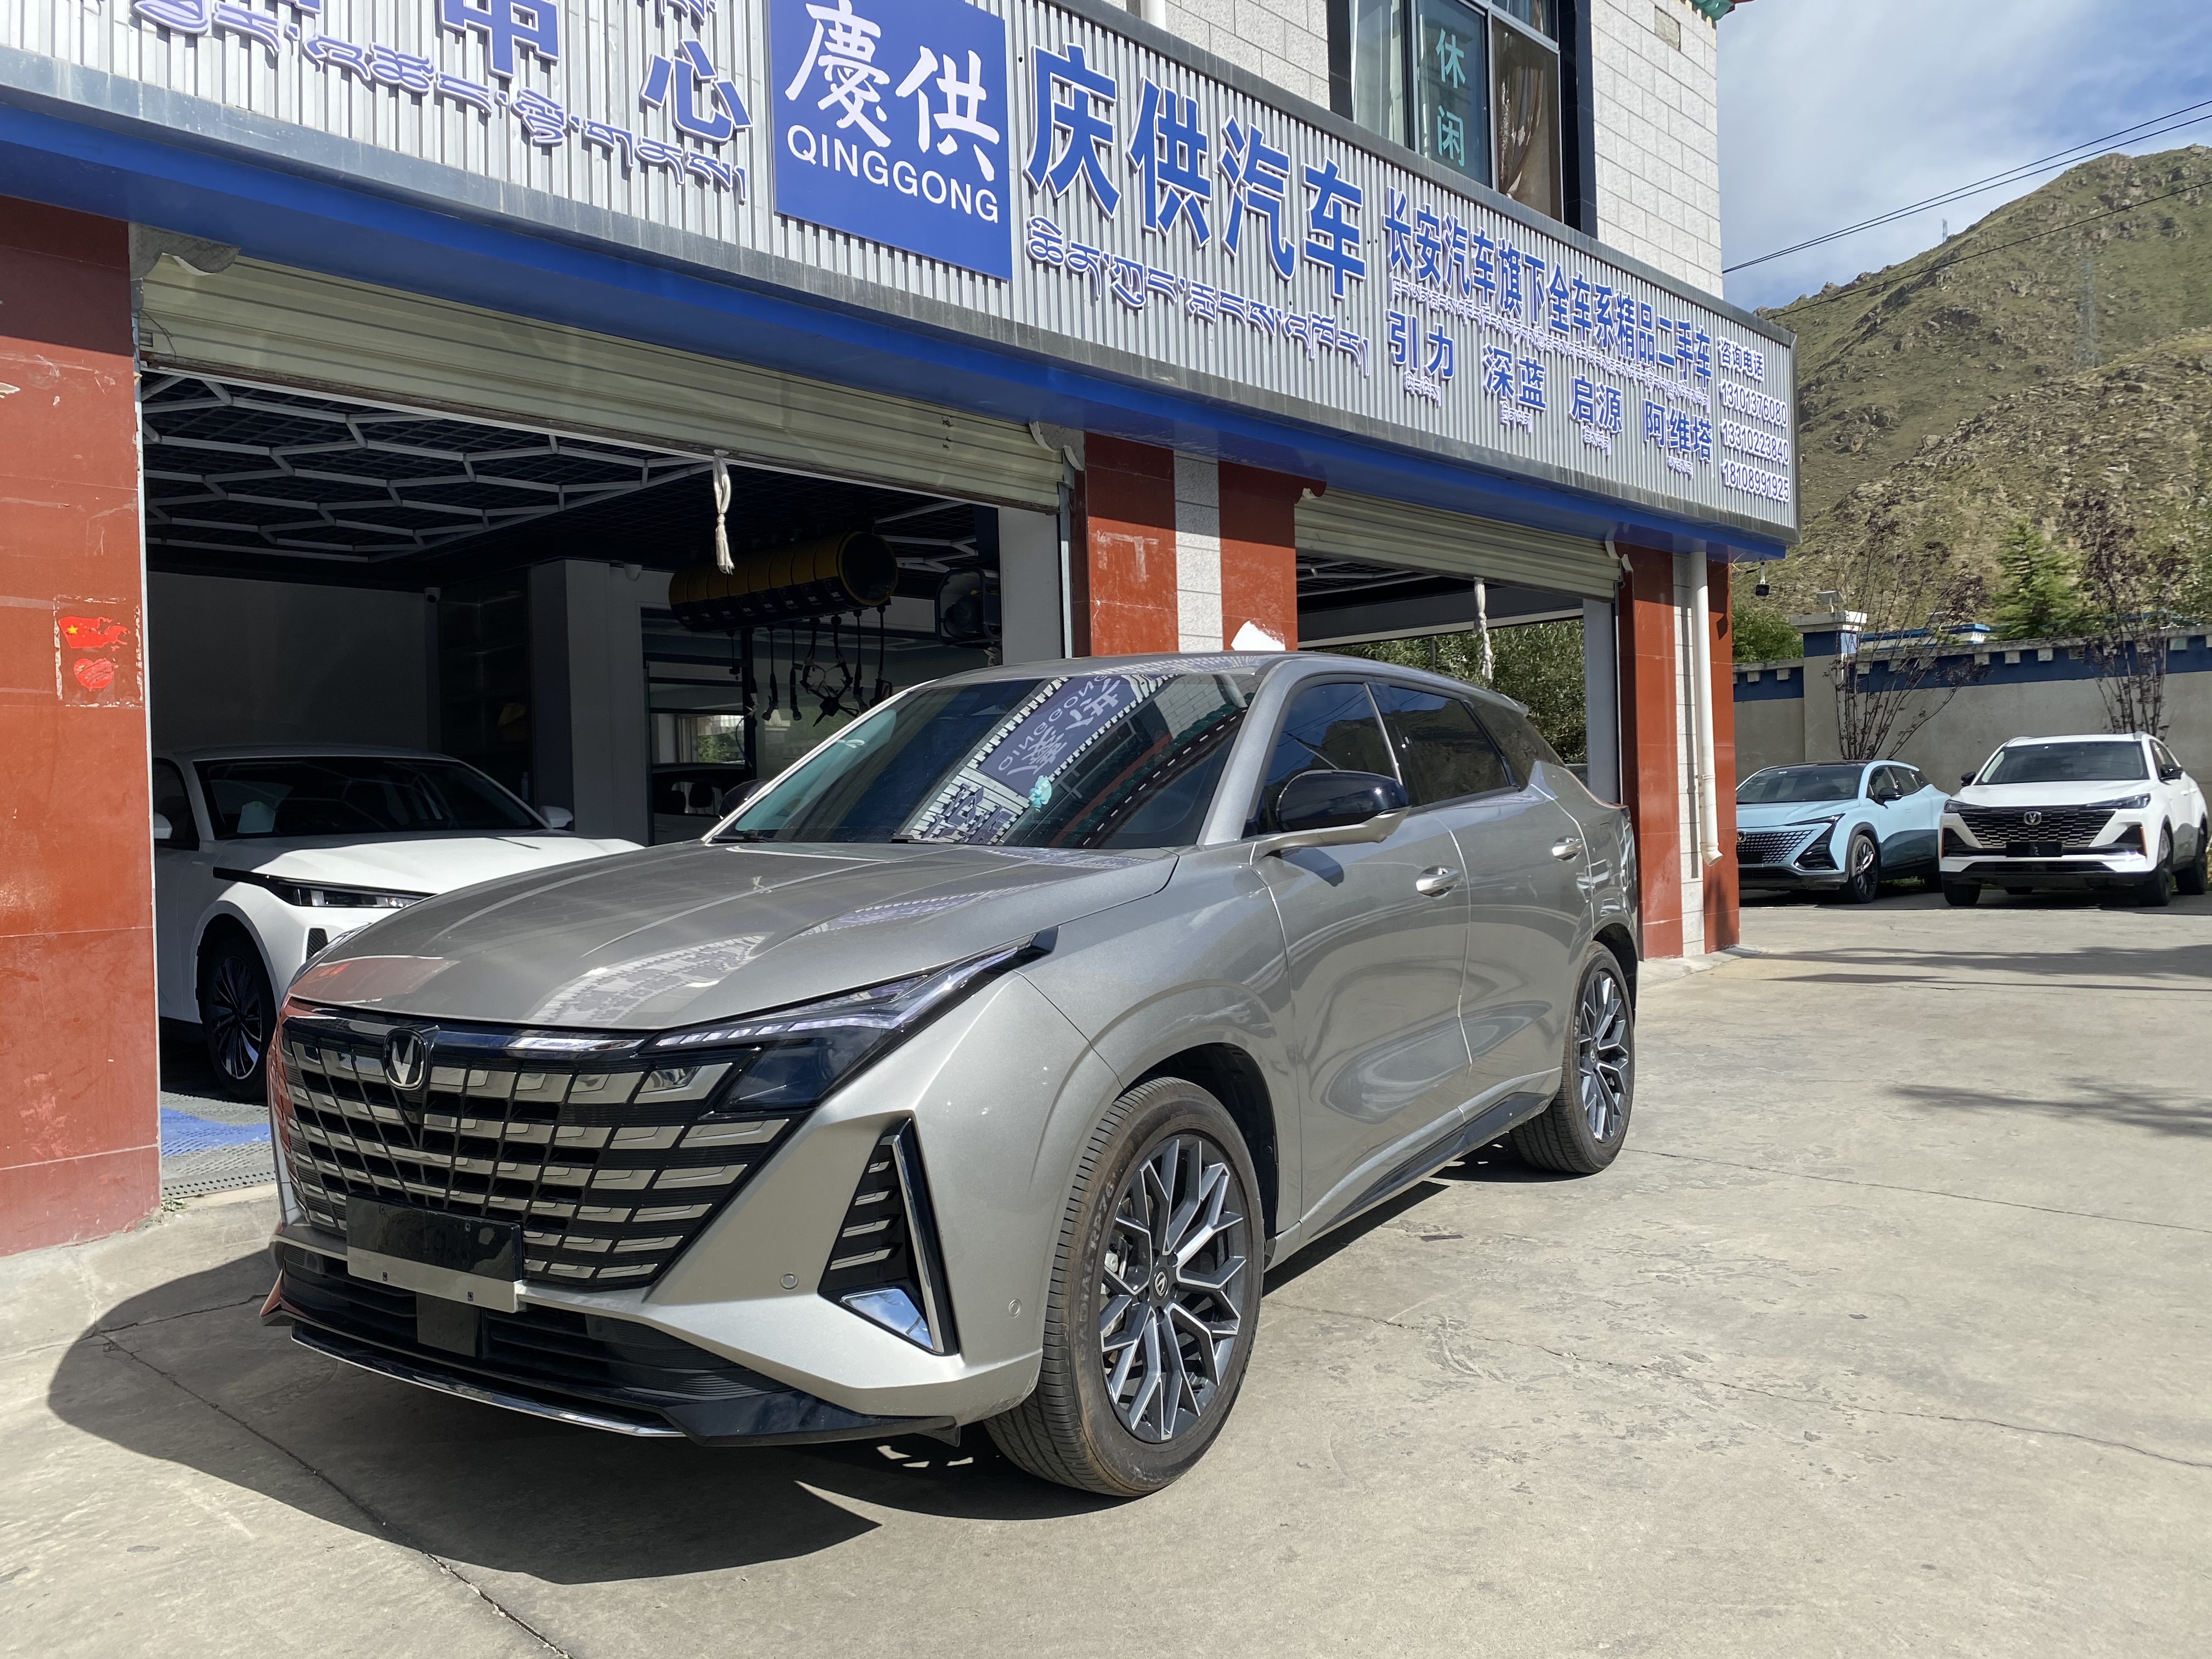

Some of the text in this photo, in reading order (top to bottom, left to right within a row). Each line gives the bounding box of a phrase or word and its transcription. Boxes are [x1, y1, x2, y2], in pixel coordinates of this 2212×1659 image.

[785, 0, 1000, 182] 慶供
[1435, 27, 1466, 167] 休闲
[787, 125, 998, 223] QINGGONG
[1023, 43, 1366, 300] 庆供汽车
[1381, 185, 1713, 394] 长安汽车旗下全车系精品二手车
[1386, 309, 1713, 463] 引力 深蓝 启源 阿维塔
[1718, 336, 1764, 382] 咨询电话
[1719, 379, 1788, 427] 13101376080
[1720, 419, 1790, 465] 13310223840
[1721, 459, 1790, 503] 18108991925
